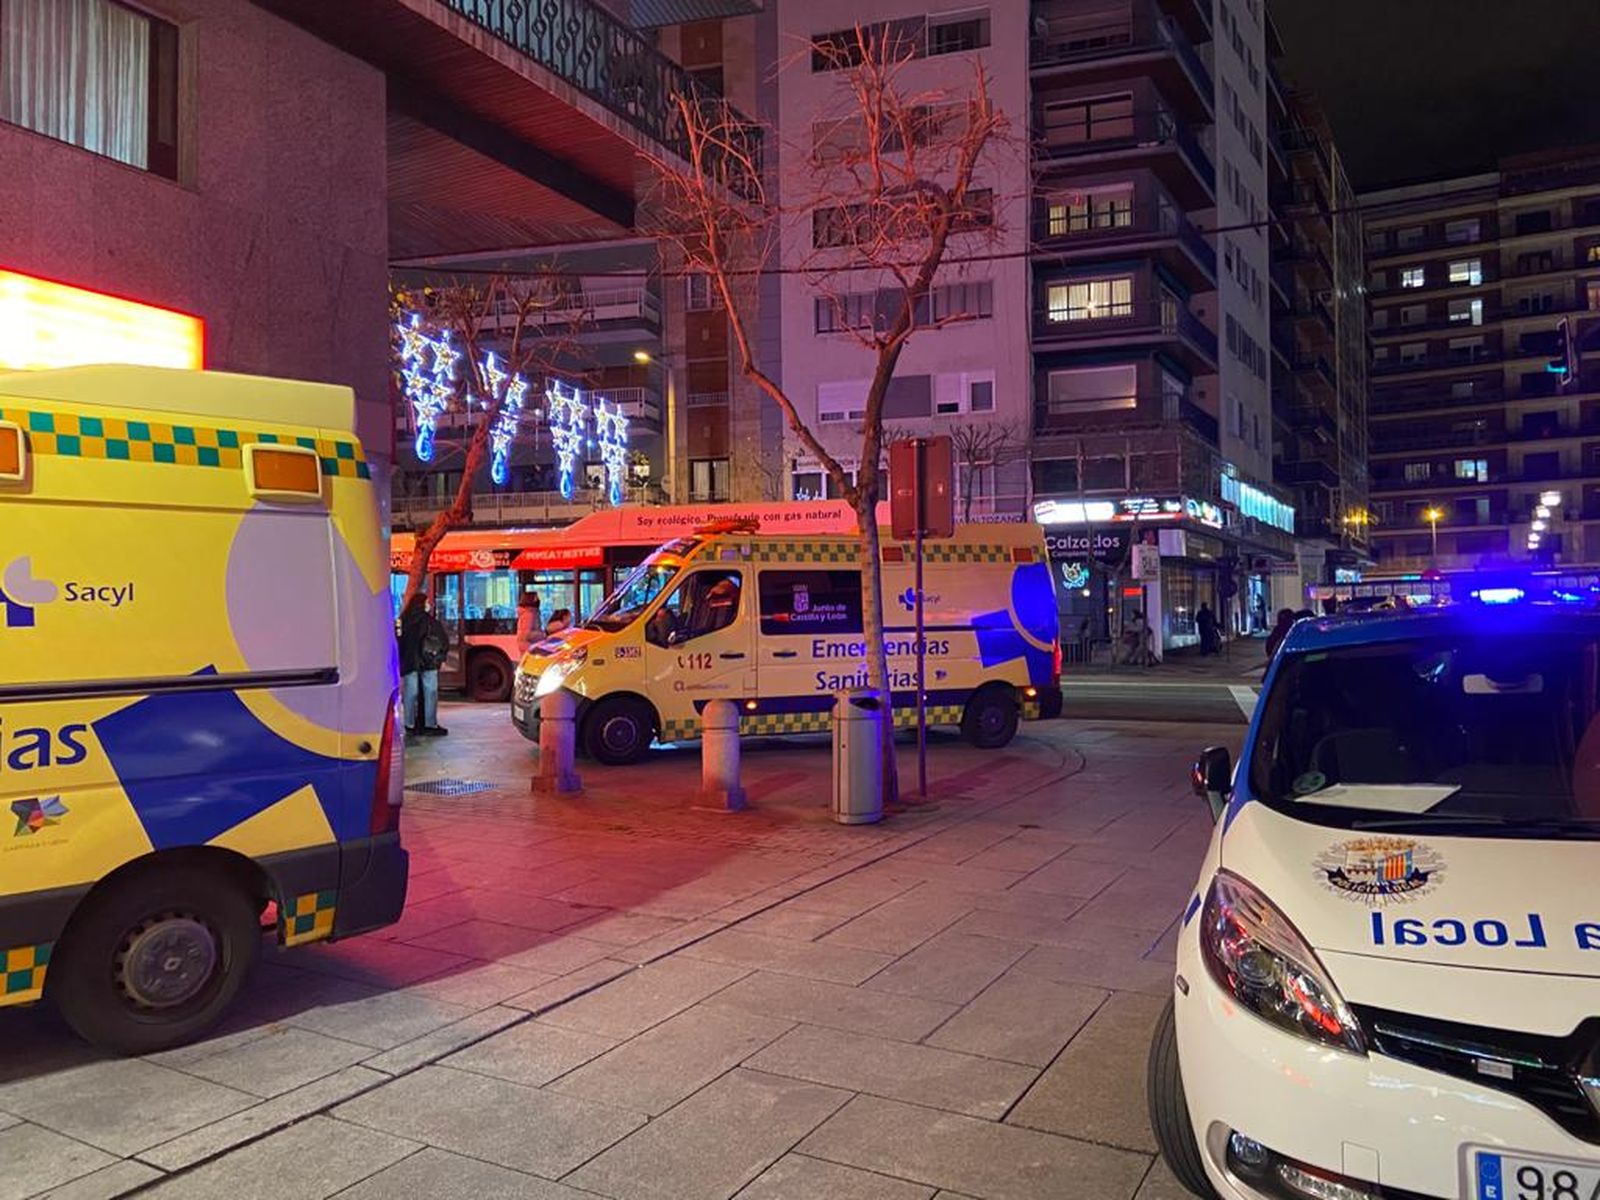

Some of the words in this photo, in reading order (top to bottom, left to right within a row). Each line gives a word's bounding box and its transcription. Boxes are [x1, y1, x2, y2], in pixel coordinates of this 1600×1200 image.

[637, 516, 653, 526] Soy
[764, 512, 780, 521] con
[784, 510, 801, 521] gas
[806, 504, 842, 519] natural
[65, 582, 133, 607] Sacyl
[812, 637, 950, 658] Emerencias
[688, 652, 712, 670] 112
[1485, 1184, 1497, 1198] E
